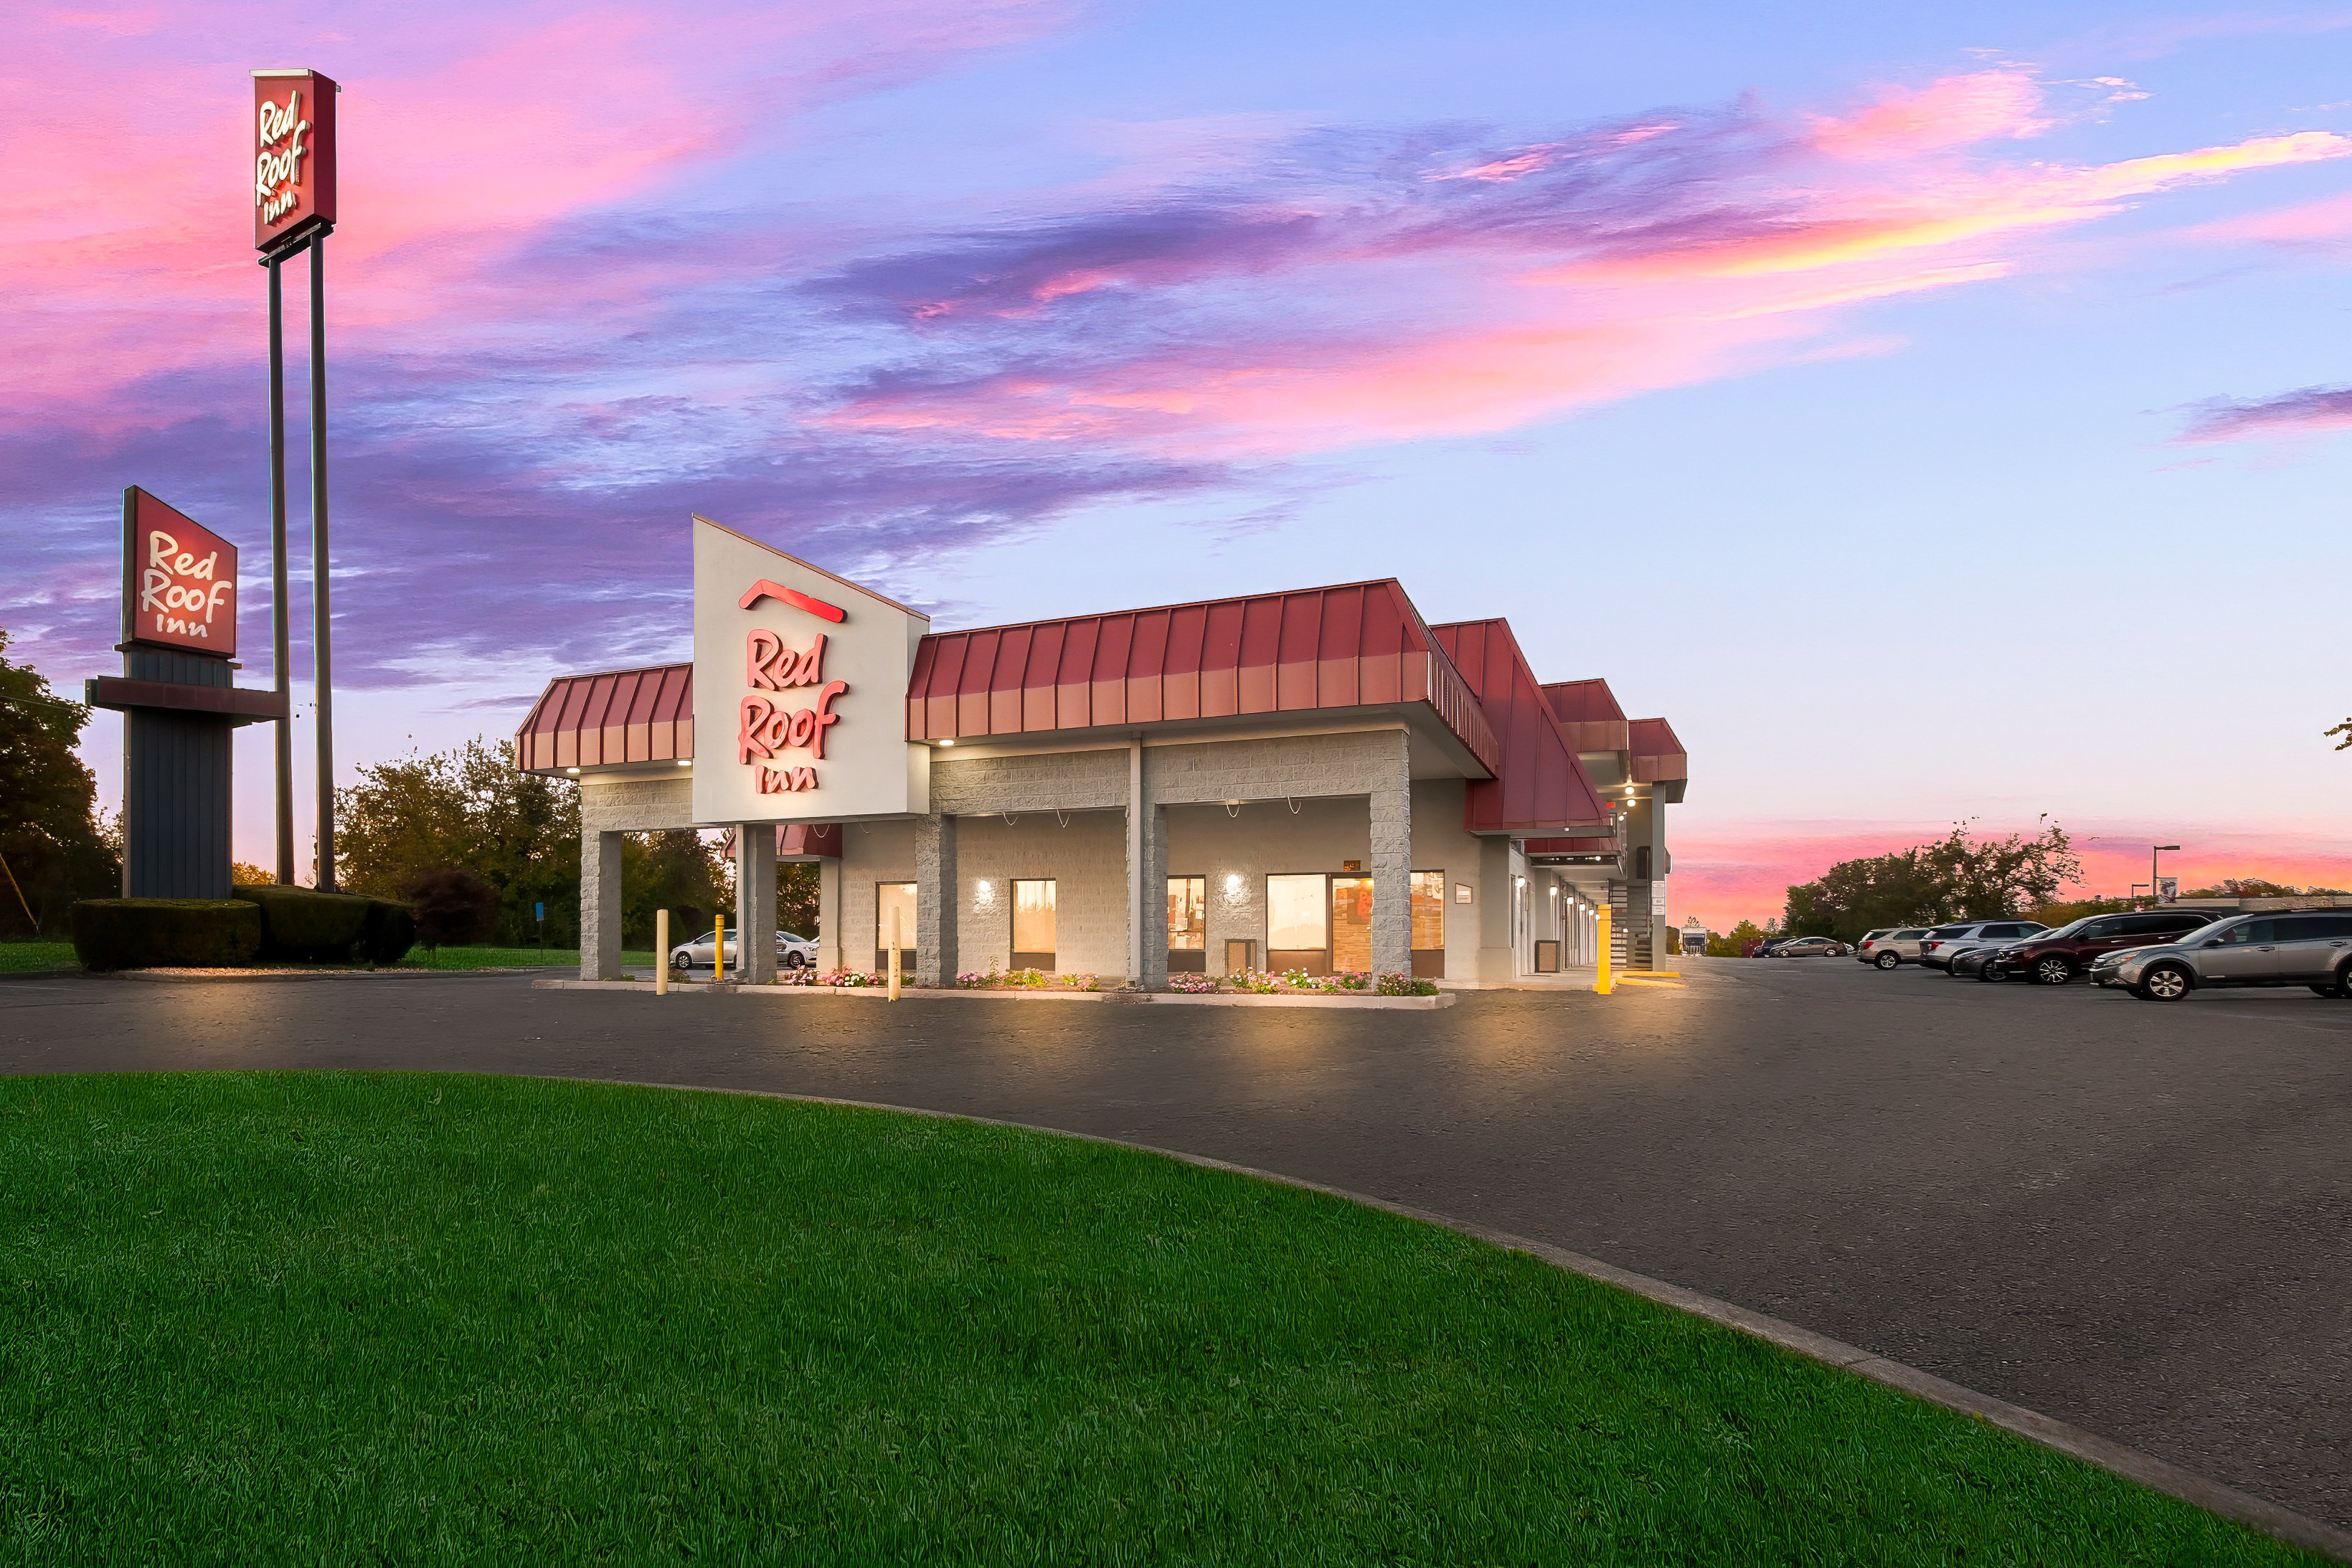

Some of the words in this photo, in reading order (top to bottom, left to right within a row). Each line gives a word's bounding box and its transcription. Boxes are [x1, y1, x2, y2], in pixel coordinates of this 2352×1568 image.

[259, 90, 301, 148] Red
[256, 119, 308, 207] Roof
[149, 530, 217, 580] Red
[141, 568, 232, 623] Roof
[747, 628, 828, 691] Red
[738, 680, 850, 765] Roof
